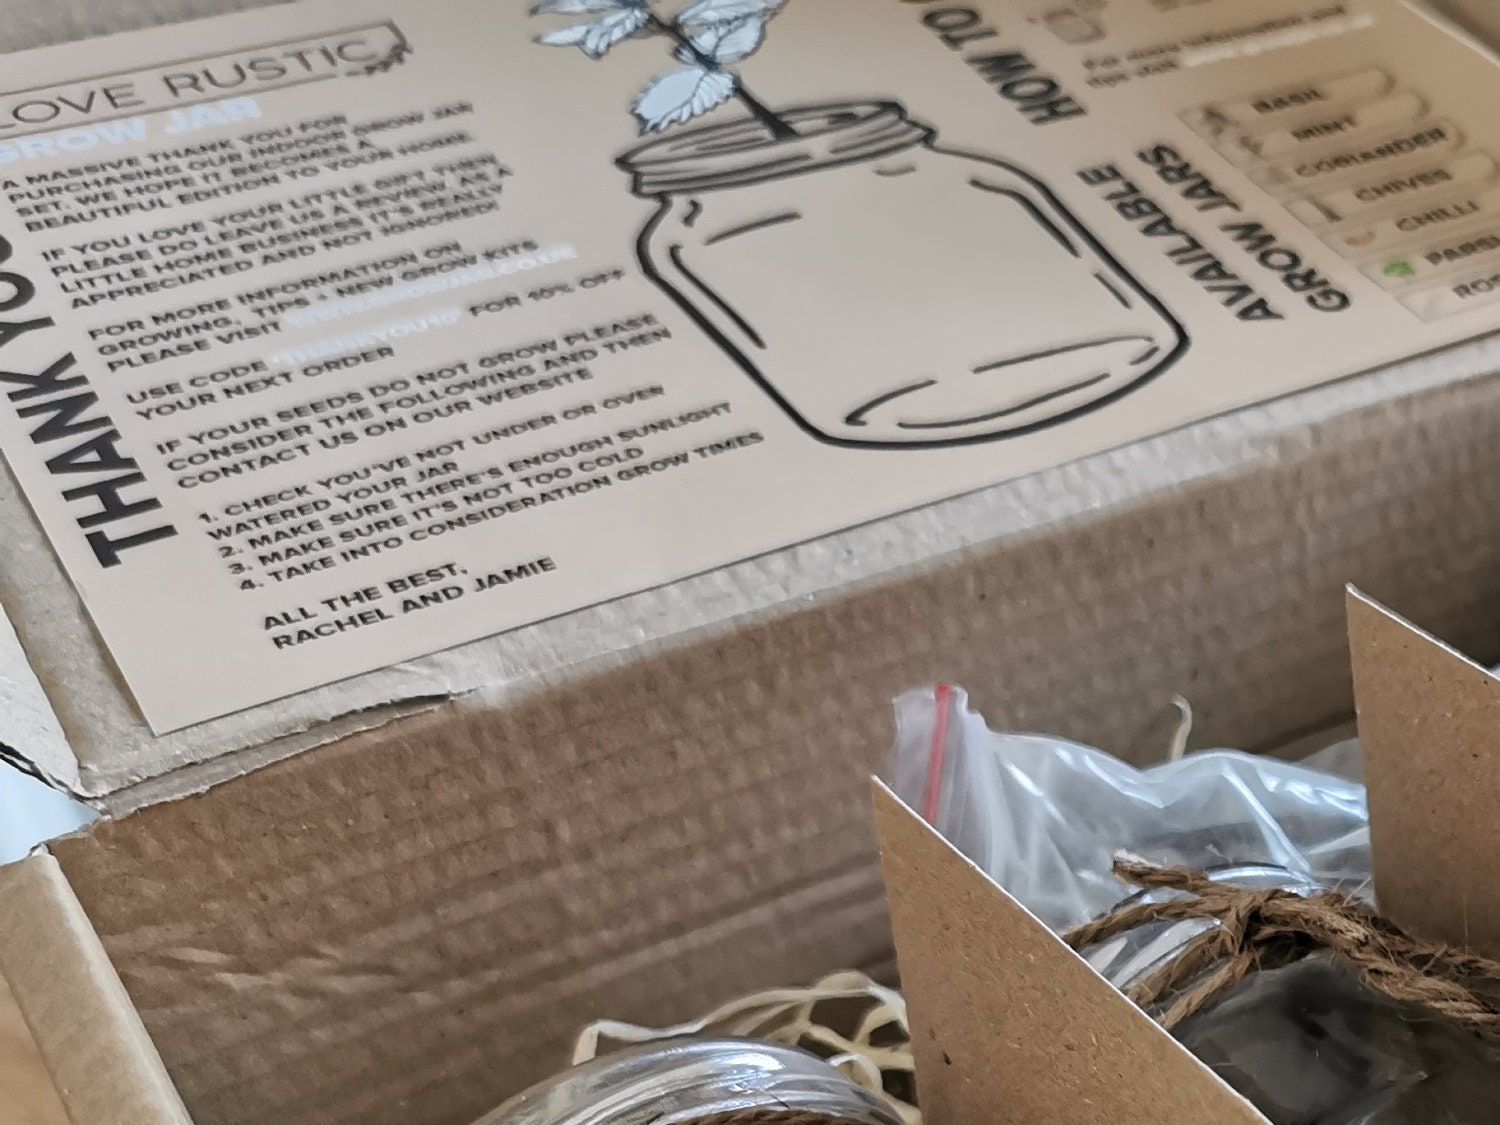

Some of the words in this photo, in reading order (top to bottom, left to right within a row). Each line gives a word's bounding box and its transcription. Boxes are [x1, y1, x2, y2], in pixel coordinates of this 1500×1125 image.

[163, 38, 380, 98] RUSTIC
[921, 7, 998, 52] TO
[164, 96, 262, 134] JAR
[964, 51, 1088, 126] HOW
[1136, 144, 1243, 212] JARS
[1295, 126, 1449, 178] CORIANDER
[1076, 165, 1285, 321] AVAILABLE
[1395, 201, 1480, 232] CHILLI
[71, 261, 254, 309] APPRECIATED
[261, 246, 316, 265] AND
[322, 229, 372, 250] NOT
[87, 320, 145, 341] FOR
[152, 299, 231, 326] MORE
[236, 252, 418, 305] INFORMATION
[424, 239, 462, 259] ON
[250, 297, 311, 318] TIPS
[335, 275, 393, 297] NEW
[400, 254, 477, 281] GROW
[481, 238, 539, 260] KITS
[1219, 221, 1351, 313] GROW
[106, 339, 211, 373] PLEASE
[215, 321, 282, 344] VISIT
[126, 382, 184, 405] USE
[189, 360, 269, 388] CODE
[468, 296, 522, 317] FOR
[136, 393, 218, 420] YOUR
[222, 371, 293, 398] NEXT
[303, 346, 395, 377] ORDER
[155, 439, 183, 455] IF
[187, 416, 270, 445] YOUR
[275, 391, 364, 422] SEEDS
[368, 379, 411, 398] DO
[416, 361, 470, 385] NOT
[478, 340, 557, 368] GROW
[562, 313, 660, 346] PLEASE
[167, 423, 313, 471] CONSIDER
[318, 405, 375, 429] THE
[377, 364, 536, 414] FOLLOWING
[543, 349, 599, 371] AND
[177, 443, 312, 489] CONTACT
[318, 431, 359, 450] US
[364, 416, 408, 438] ON
[413, 400, 474, 423] OUR
[475, 367, 594, 406] WEBSITE
[224, 484, 314, 517] CHECK
[316, 456, 413, 491] YOU'VE
[415, 439, 466, 462] NOT
[472, 414, 558, 445] UNDER
[562, 403, 597, 421] OR
[602, 384, 666, 409] OVER
[0, 352, 179, 569] THANK
[206, 498, 332, 541] WATERED
[335, 475, 408, 504] YOUR
[416, 460, 460, 483] JAR
[218, 545, 244, 558] 2.
[247, 518, 325, 550] MAKE
[328, 498, 399, 526] SURE
[400, 466, 504, 503] THERE'S
[507, 435, 615, 473] ENOUGH
[616, 401, 732, 443] SUNLIGHT
[227, 562, 253, 575] 3.
[258, 535, 336, 567] MAKE
[338, 514, 409, 542] SURE
[411, 500, 459, 521] IT'S
[462, 482, 514, 506] NOT
[520, 467, 573, 489] TOO
[578, 447, 644, 472] COLD
[240, 579, 264, 591] 4.
[267, 555, 338, 583] TAKE
[339, 536, 403, 563] INTO
[408, 474, 612, 541] CONSIDERATION
[617, 452, 689, 481] GROW
[693, 432, 764, 459] TIMES
[263, 606, 319, 630] ALL
[320, 585, 384, 612] THE
[272, 607, 394, 650] RACHEL
[401, 585, 465, 614] AND
[474, 556, 558, 593] JAMIE
